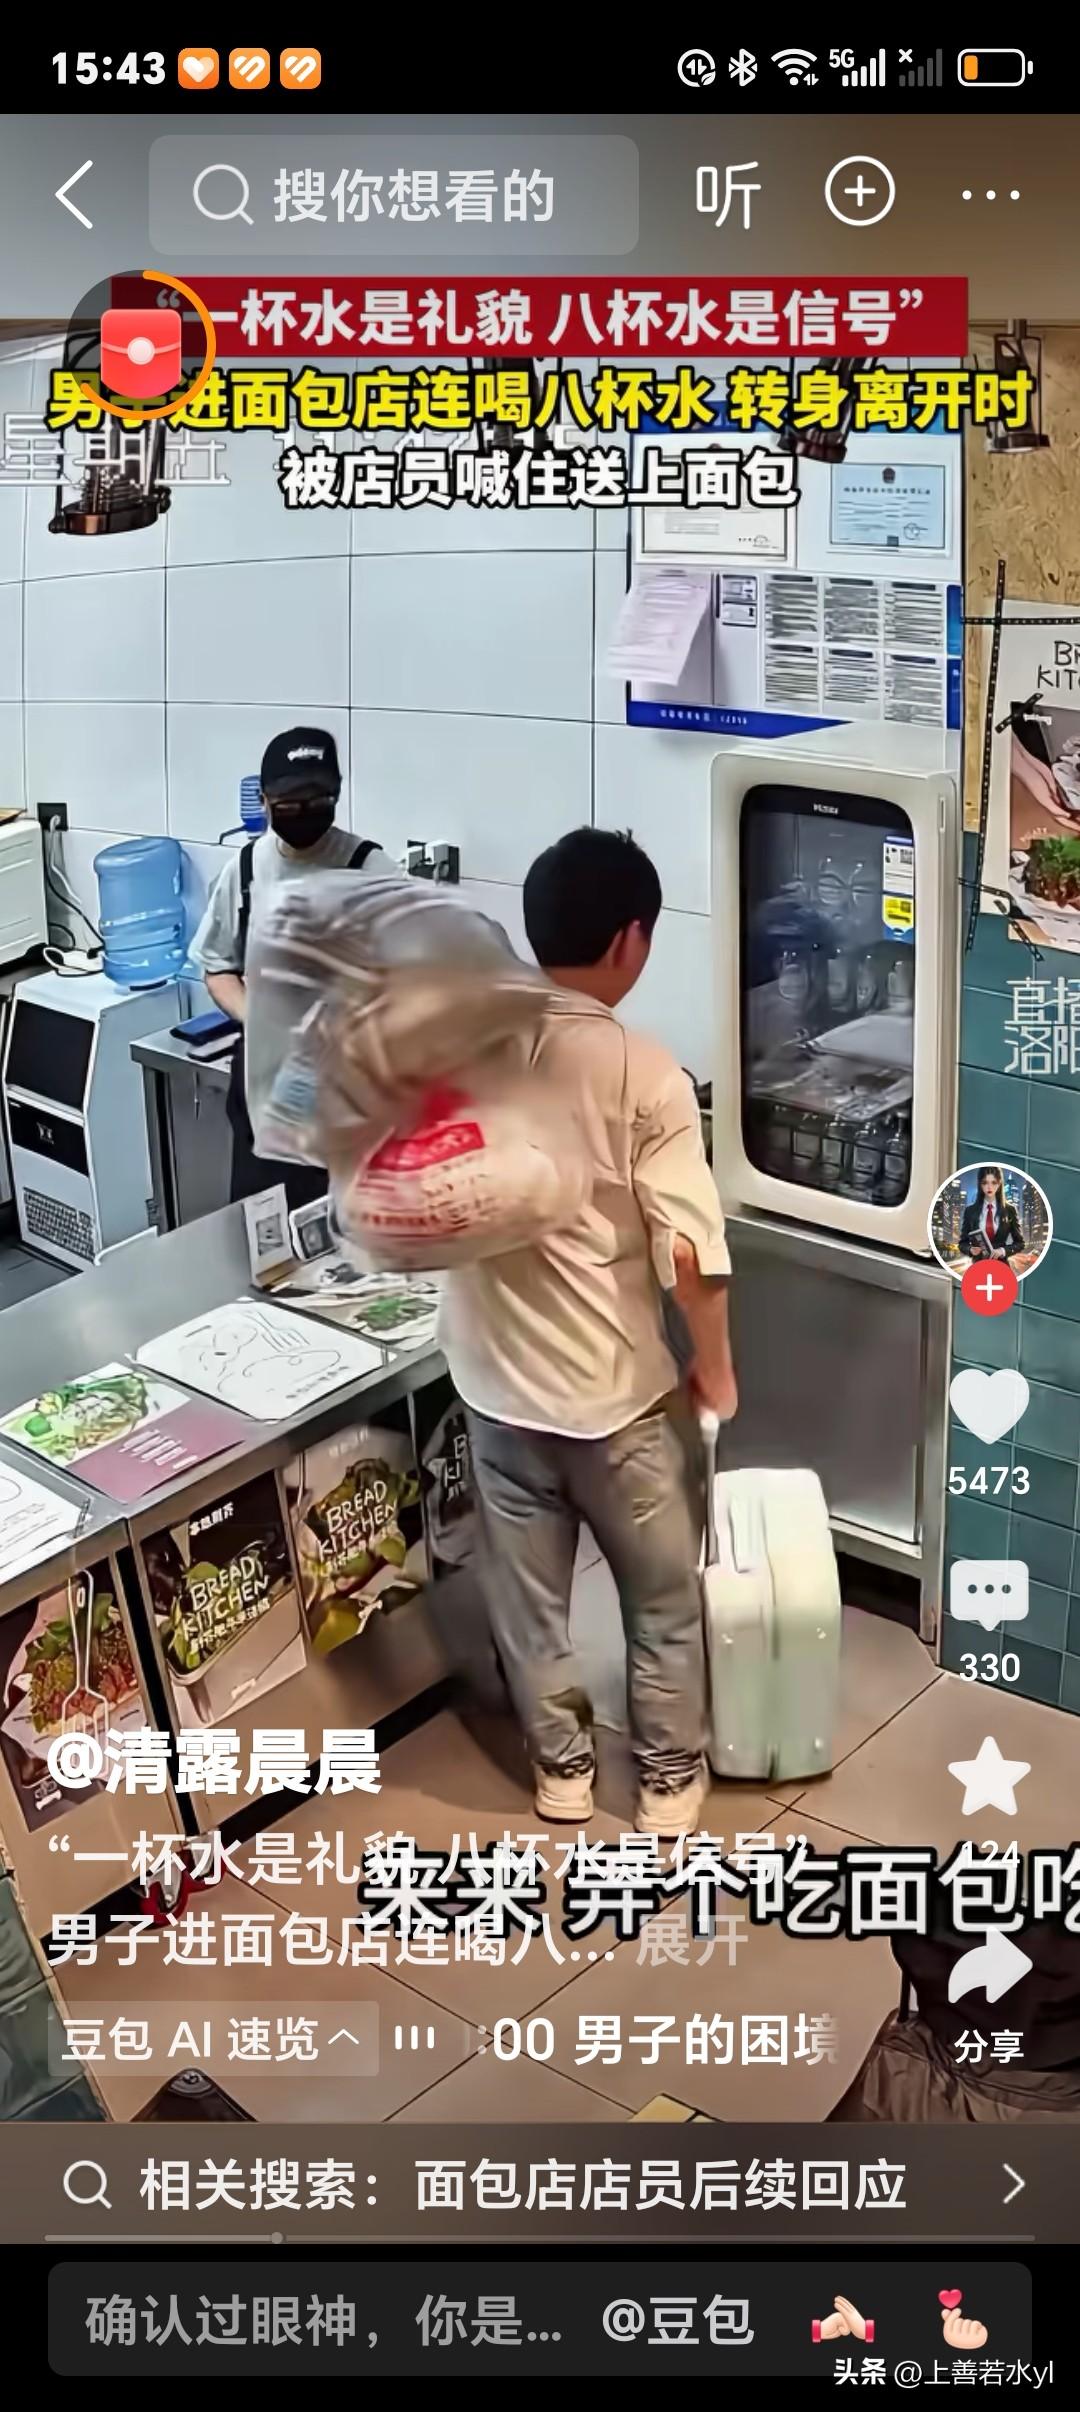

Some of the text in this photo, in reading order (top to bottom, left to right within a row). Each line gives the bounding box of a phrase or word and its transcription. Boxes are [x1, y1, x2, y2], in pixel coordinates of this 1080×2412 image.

[317, 1502, 398, 1564] KITCHEN
[326, 1480, 387, 1533] BREAD
[182, 1575, 270, 1642] KITCHEN
[190, 1556, 256, 1612] BREAD
